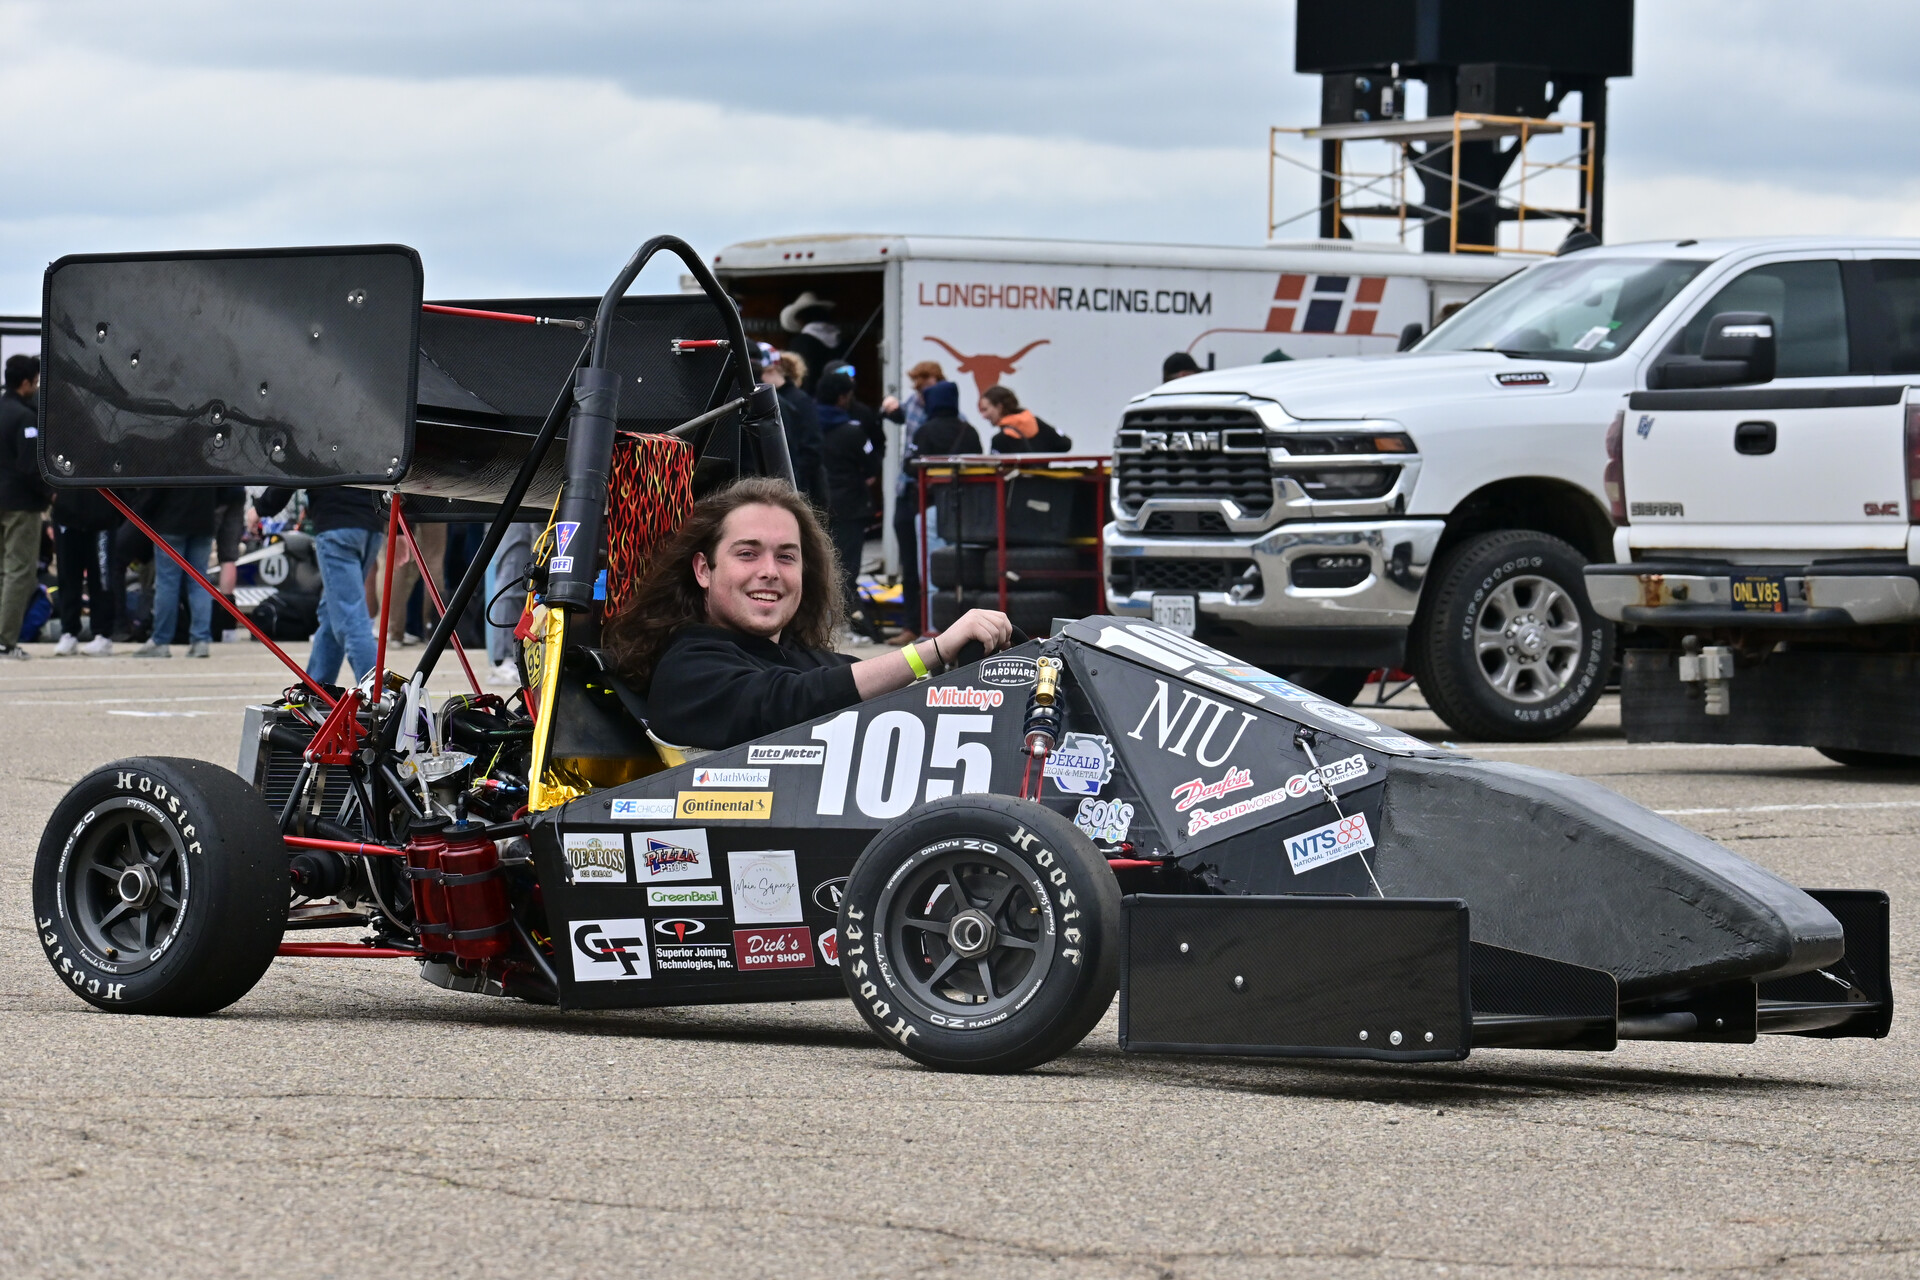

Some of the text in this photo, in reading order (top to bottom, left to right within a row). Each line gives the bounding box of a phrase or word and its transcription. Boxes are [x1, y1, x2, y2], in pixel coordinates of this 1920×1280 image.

[919, 282, 1211, 315] LONGHORNRACING.COM
[1501, 373, 1544, 382] 2500
[1142, 432, 1220, 451] RAM
[1631, 502, 1683, 516] SIERRA
[1864, 502, 1899, 516] GMC
[265, 561, 283, 578] 41
[552, 561, 569, 570] OFF
[1095, 625, 1251, 671] 10
[528, 644, 541, 678] 93
[984, 667, 1036, 678] HARDWARE
[929, 688, 1002, 709] Mitutoyo
[1127, 679, 1258, 768] NIU
[751, 748, 822, 761] Auto Meter
[811, 711, 994, 819] 105
[1046, 753, 1101, 770] DEKALB
[712, 771, 767, 783] MathWorks
[1044, 766, 1064, 776] IRON
[1072, 769, 1099, 780] METAL
[1308, 756, 1364, 784] CDEAS
[1174, 768, 1252, 811] Danfoss
[114, 771, 202, 855] Hoosier
[614, 800, 673, 815] SAE CHICAGO
[682, 798, 754, 815] Continental
[1080, 797, 1134, 831] SOAS
[1213, 790, 1285, 822] SOLIDWORKS
[58, 837, 74, 873] RACING
[921, 840, 960, 856] RACING
[1292, 829, 1337, 861] NTS
[567, 849, 625, 873] JOE & ROSS
[645, 847, 699, 868] PIZZA
[1294, 854, 1325, 869] NATIONAL
[1325, 846, 1343, 858] TUBE
[580, 870, 613, 878] ICE CREAM
[651, 890, 718, 903] GreenBasil
[733, 877, 797, 898] Main Squeeze
[1008, 825, 1082, 966] Hoosier
[171, 898, 188, 936] RACING
[656, 947, 727, 960] Superior Joining
[747, 933, 800, 953] Dick's
[38, 917, 127, 1000] Hoosier
[79, 948, 118, 973] Formula Student
[659, 959, 734, 971] Technologies, Inc.
[745, 953, 806, 965] BODY SHOP
[873, 932, 896, 989] Formula Student
[846, 904, 920, 1045] Hoosier
[1015, 978, 1043, 1011] MAGNESIUM
[969, 1012, 1008, 1028] RACING
